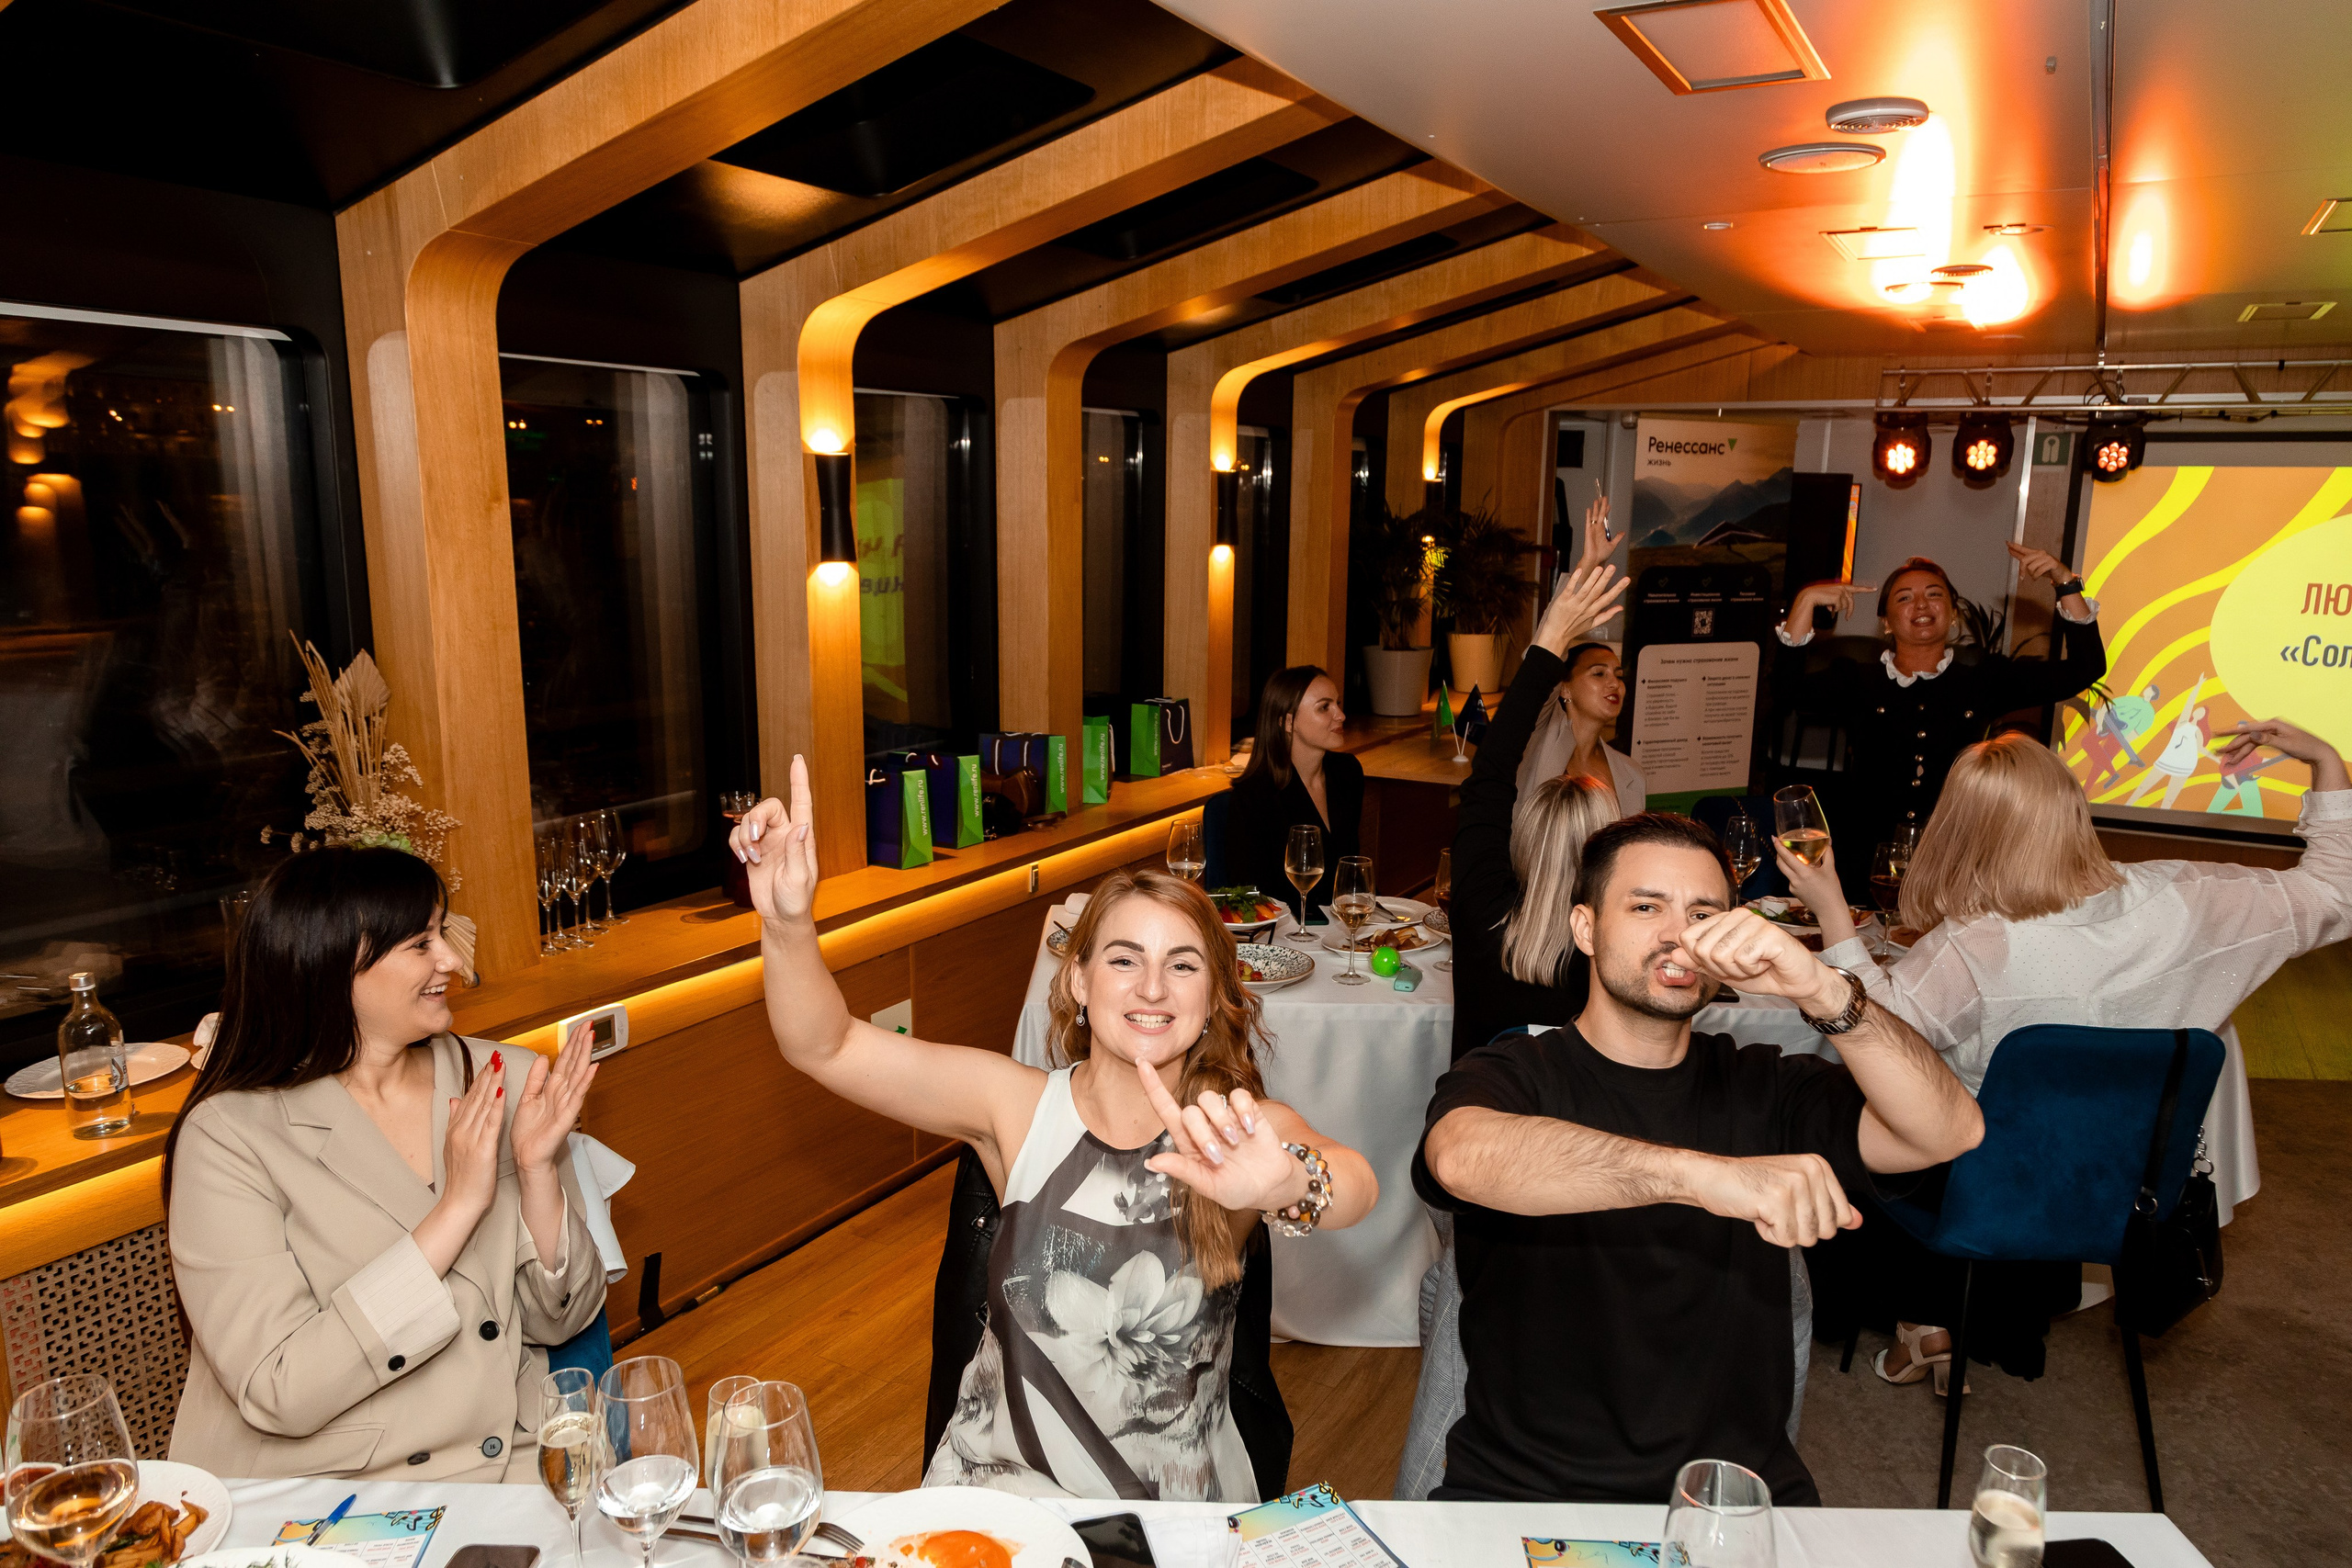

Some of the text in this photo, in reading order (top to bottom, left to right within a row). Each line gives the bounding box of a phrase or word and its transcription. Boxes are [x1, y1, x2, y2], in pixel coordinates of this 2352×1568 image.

[1647, 458, 1671, 467] жизнь
[1648, 435, 1725, 456] Ренессанс
[2301, 582, 2352, 616] ЛЮ
[917, 779, 928, 836] www.renlife.ru
[970, 763, 979, 818] www.renlife.ru
